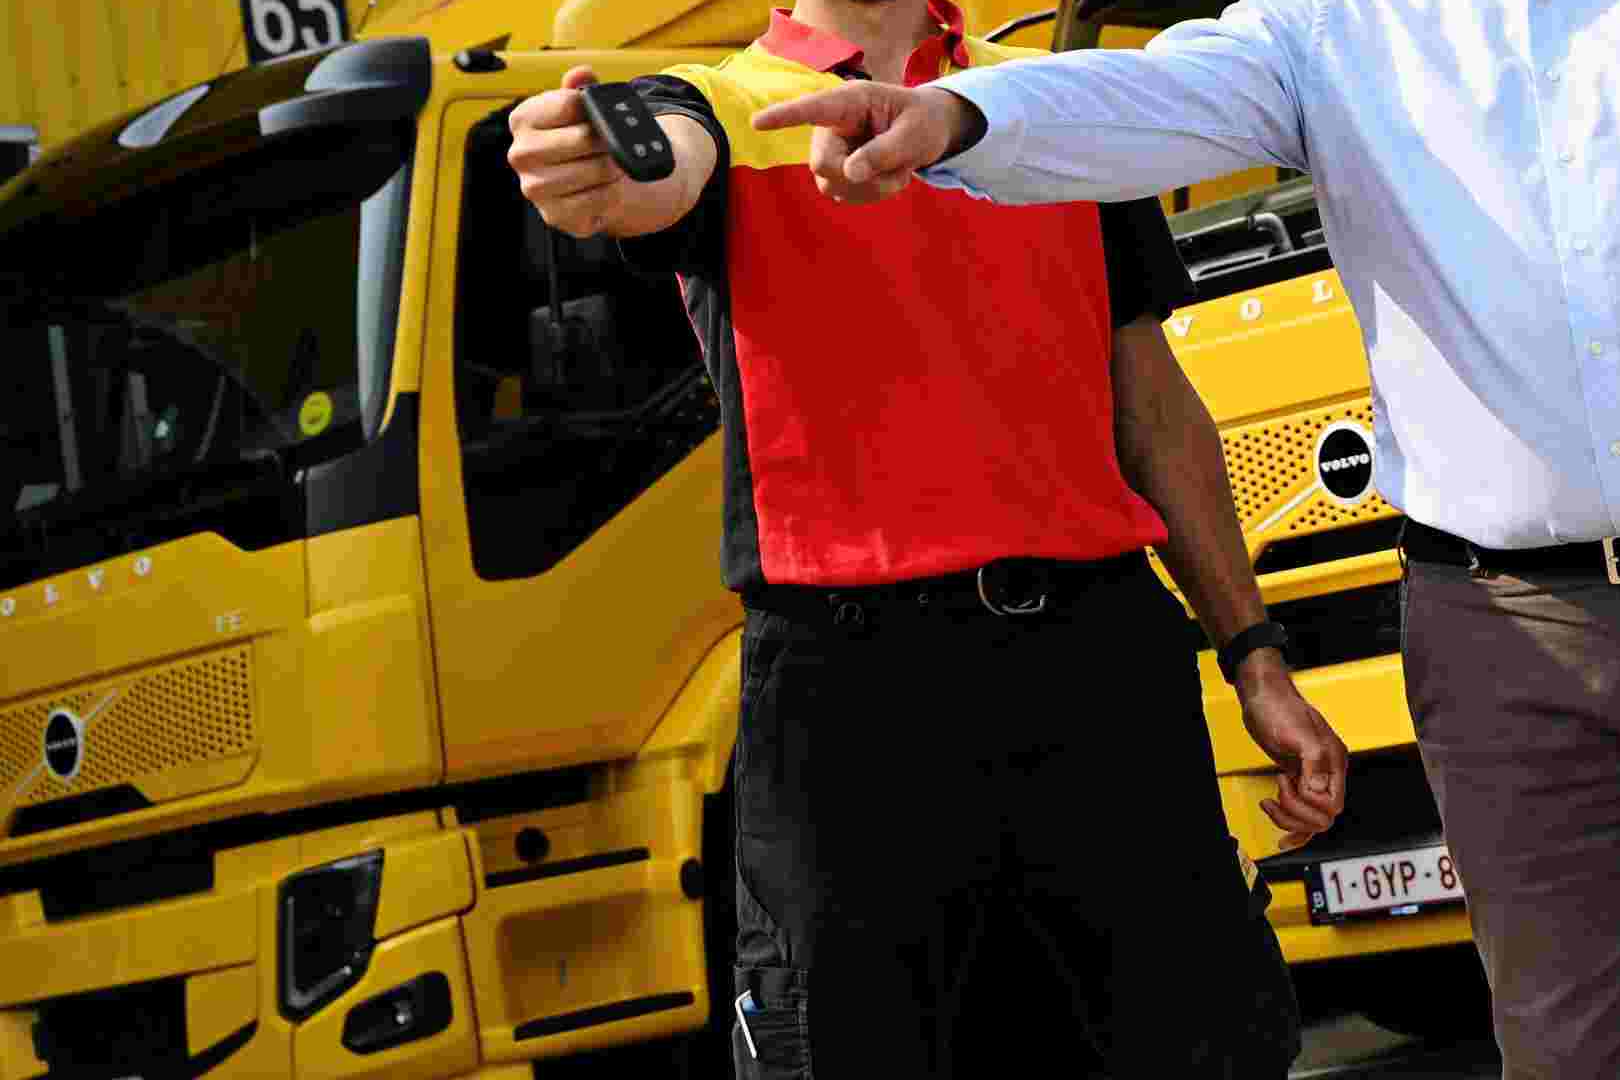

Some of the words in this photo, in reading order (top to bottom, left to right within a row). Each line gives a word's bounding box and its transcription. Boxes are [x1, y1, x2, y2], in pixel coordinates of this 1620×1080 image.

[1171, 278, 1334, 337] VOL
[1319, 452, 1371, 473] VOLVO
[0, 556, 152, 617] OLVO
[1330, 855, 1457, 906] 1-GYP-8
